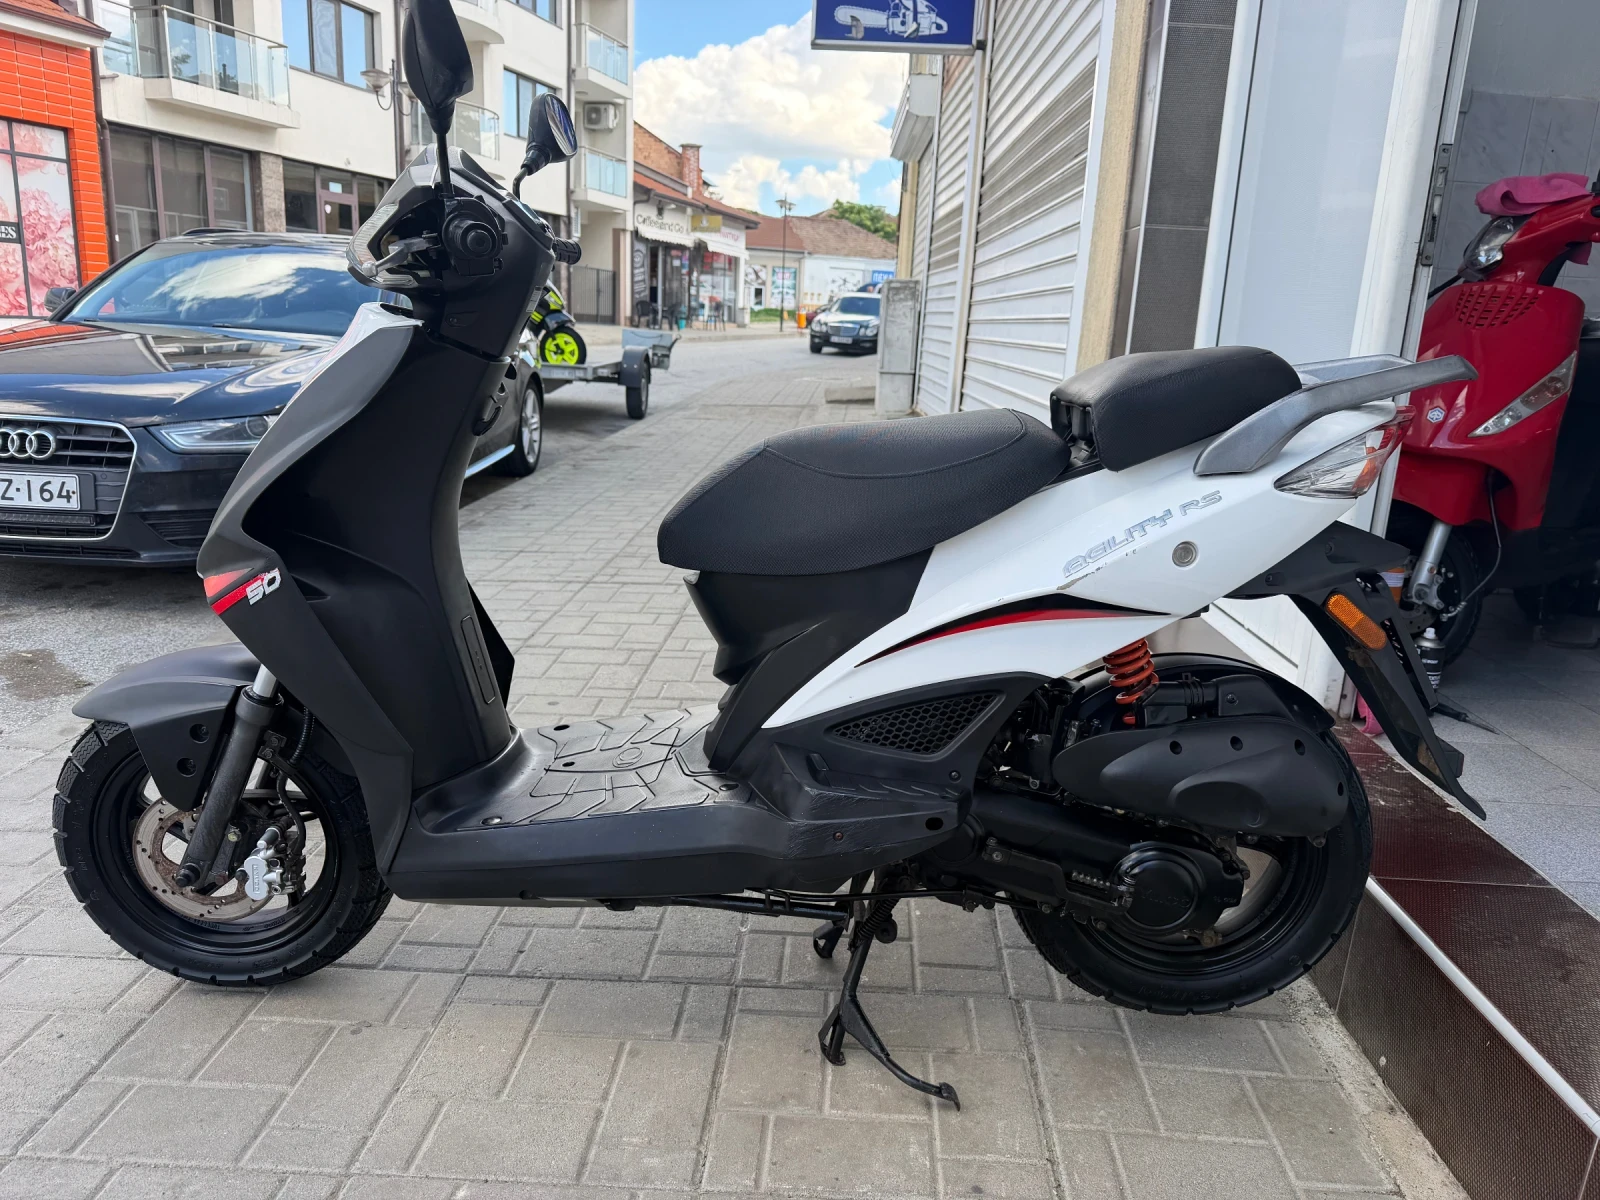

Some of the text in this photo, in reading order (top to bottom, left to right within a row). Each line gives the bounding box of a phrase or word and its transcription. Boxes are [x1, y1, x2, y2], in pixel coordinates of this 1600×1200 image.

[1062, 490, 1223, 578] AGILITY RS
[245, 567, 282, 606] 50
